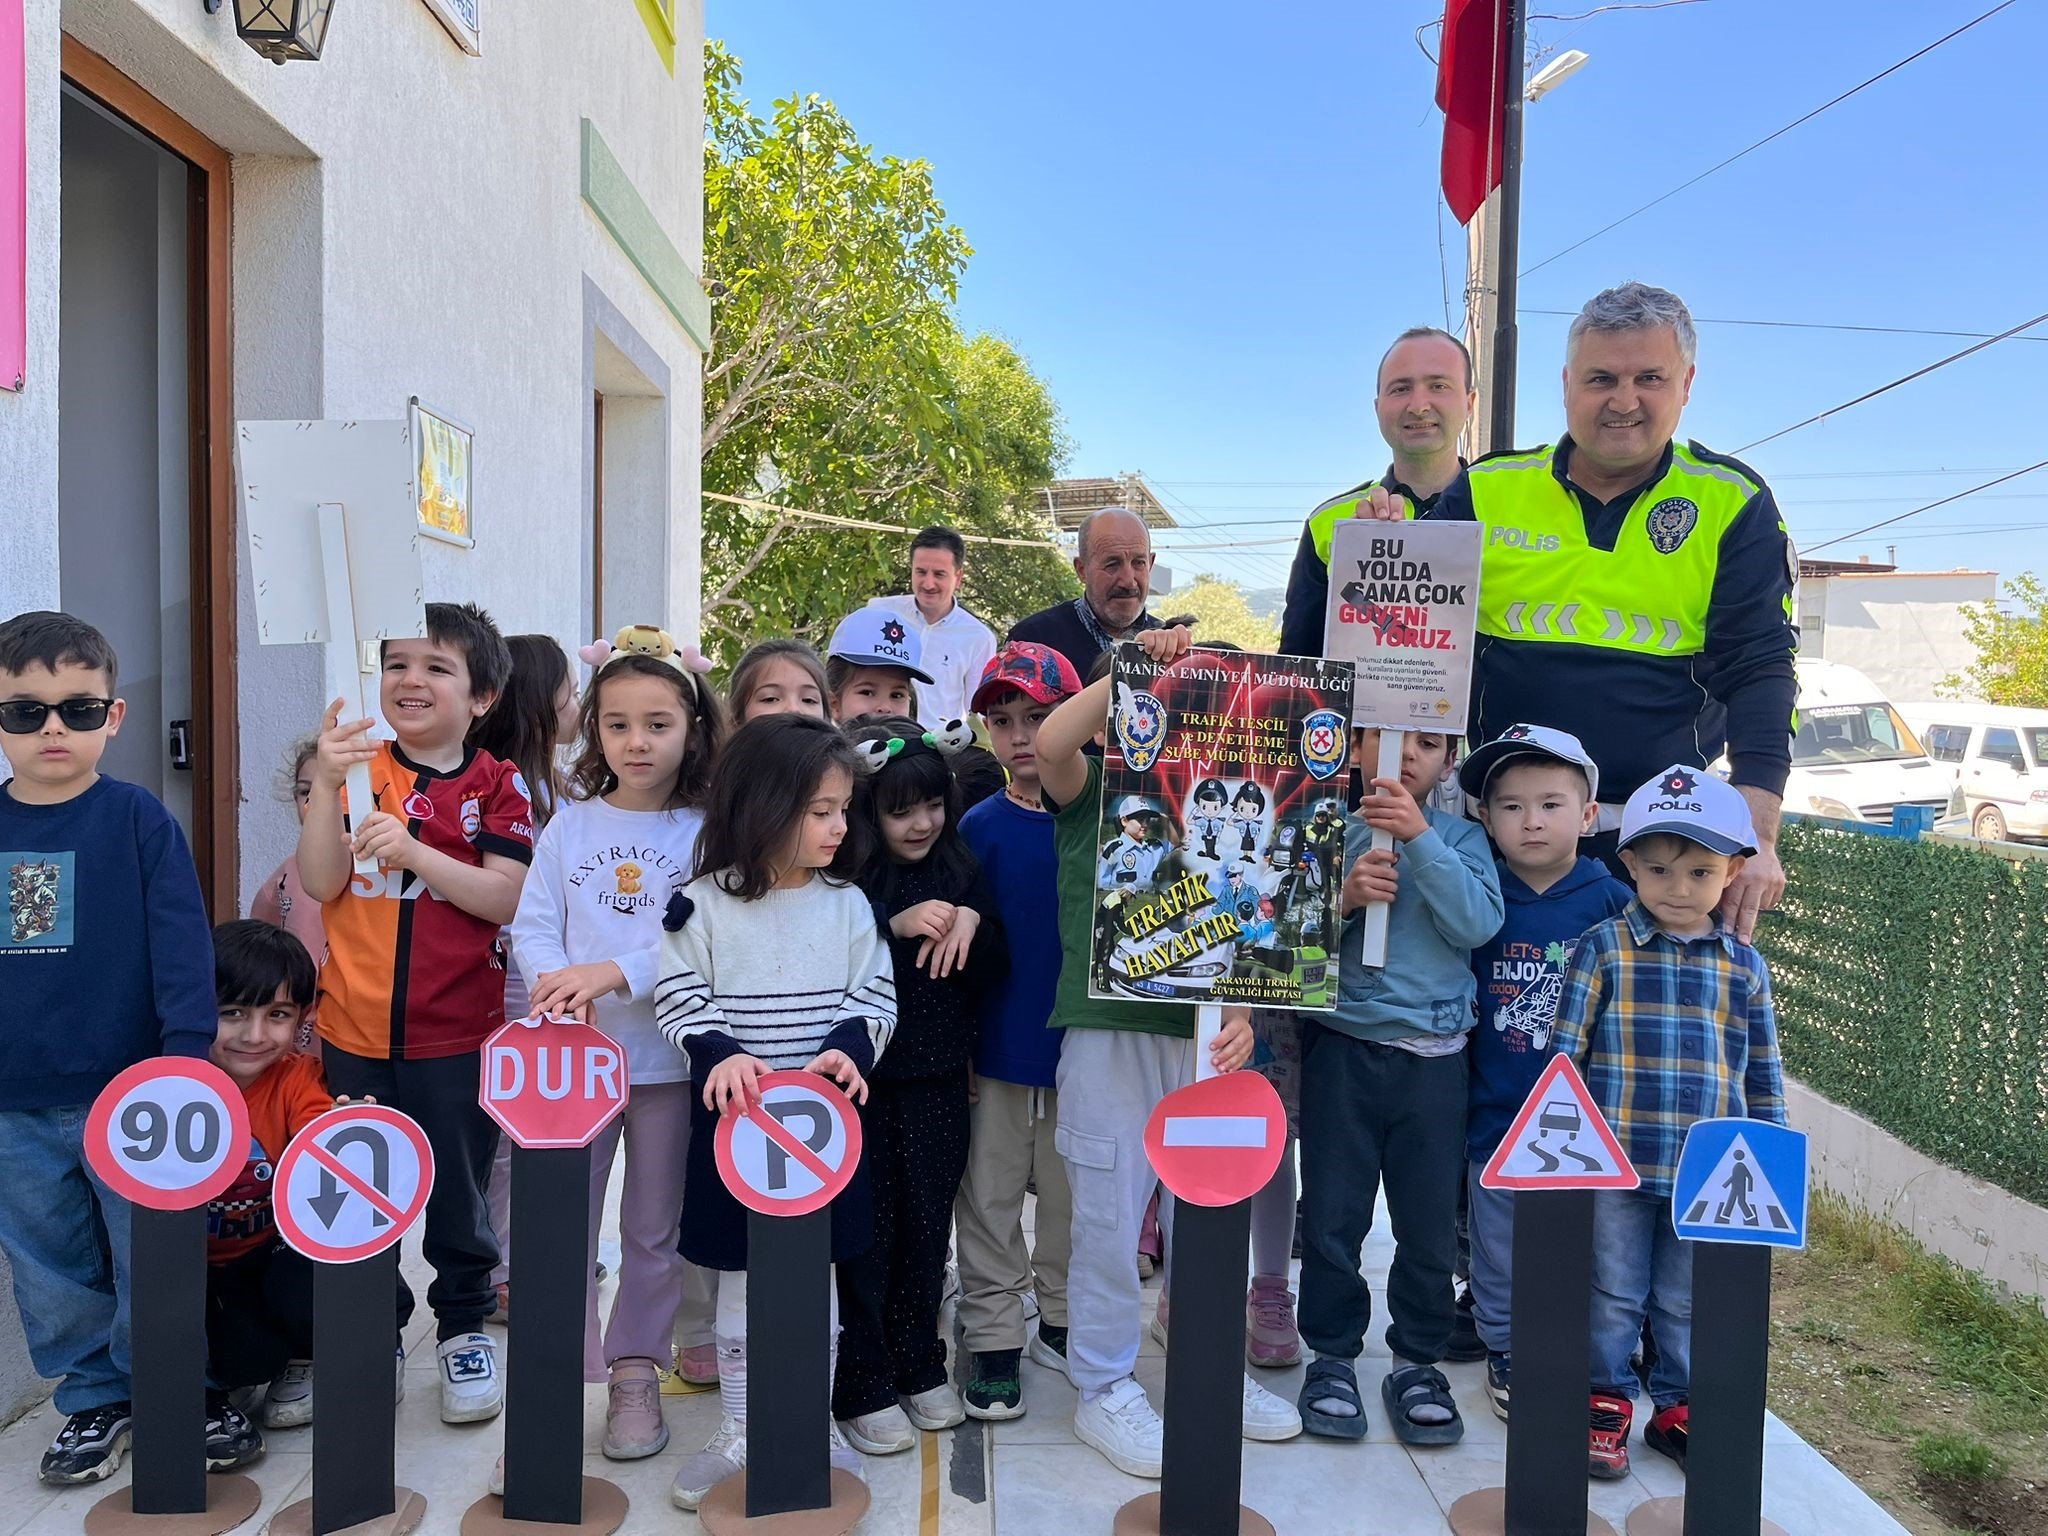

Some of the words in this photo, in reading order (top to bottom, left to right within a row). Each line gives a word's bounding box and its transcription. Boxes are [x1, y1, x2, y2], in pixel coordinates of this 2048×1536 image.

[1370, 538, 1404, 559] BU
[1357, 560, 1432, 582] YOLDA
[1414, 583, 1467, 605] ÇOK
[1372, 626, 1457, 650] YORUZ.
[1356, 656, 1382, 664] Yolumuz
[1383, 657, 1403, 665] dikkat
[1117, 661, 1176, 678] MANİSA
[1180, 666, 1248, 685] EMNİYET
[1254, 671, 1351, 692] MÜDÜRLÜĞÜ
[1180, 712, 1234, 728] TRAFİK
[1238, 717, 1288, 732] TESCİL
[1197, 731, 1285, 749] DENETLEME
[1165, 745, 1201, 760] ŞUBE
[1205, 748, 1298, 767] MÜDÜRLÜĞÜ
[597, 890, 656, 907] friends
[1124, 869, 1215, 940] TRAFİK
[1124, 912, 1241, 978] HAYATTIR
[1213, 976, 1264, 986] KARAYOLU
[1265, 978, 1299, 988] TRAFİK
[1493, 961, 1548, 982] ENJOY
[1209, 985, 1261, 997] GÜVENLİĞİ
[1263, 989, 1302, 999] HAFTASI
[1488, 982, 1520, 998] today
[489, 1046, 619, 1101] DUR
[120, 1100, 220, 1163] 90
[763, 1099, 833, 1190] P
